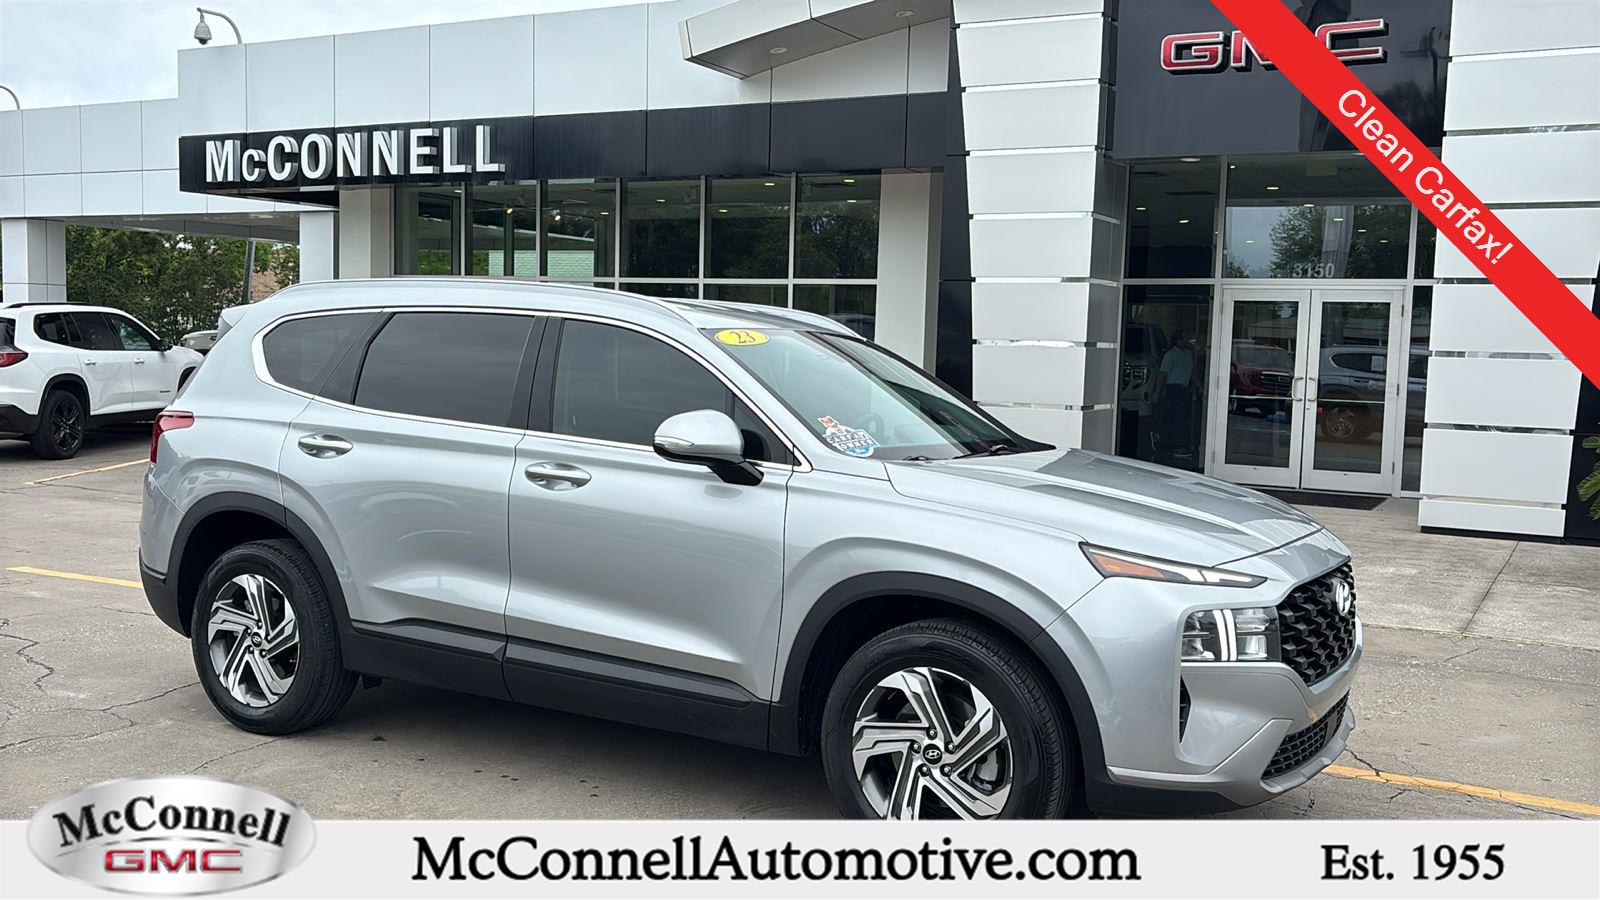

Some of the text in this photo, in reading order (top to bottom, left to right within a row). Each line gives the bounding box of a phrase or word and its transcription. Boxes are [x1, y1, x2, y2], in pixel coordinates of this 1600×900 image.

[205, 124, 506, 183] McCONNELL
[1292, 262, 1335, 278] 3150
[729, 330, 756, 344] 23
